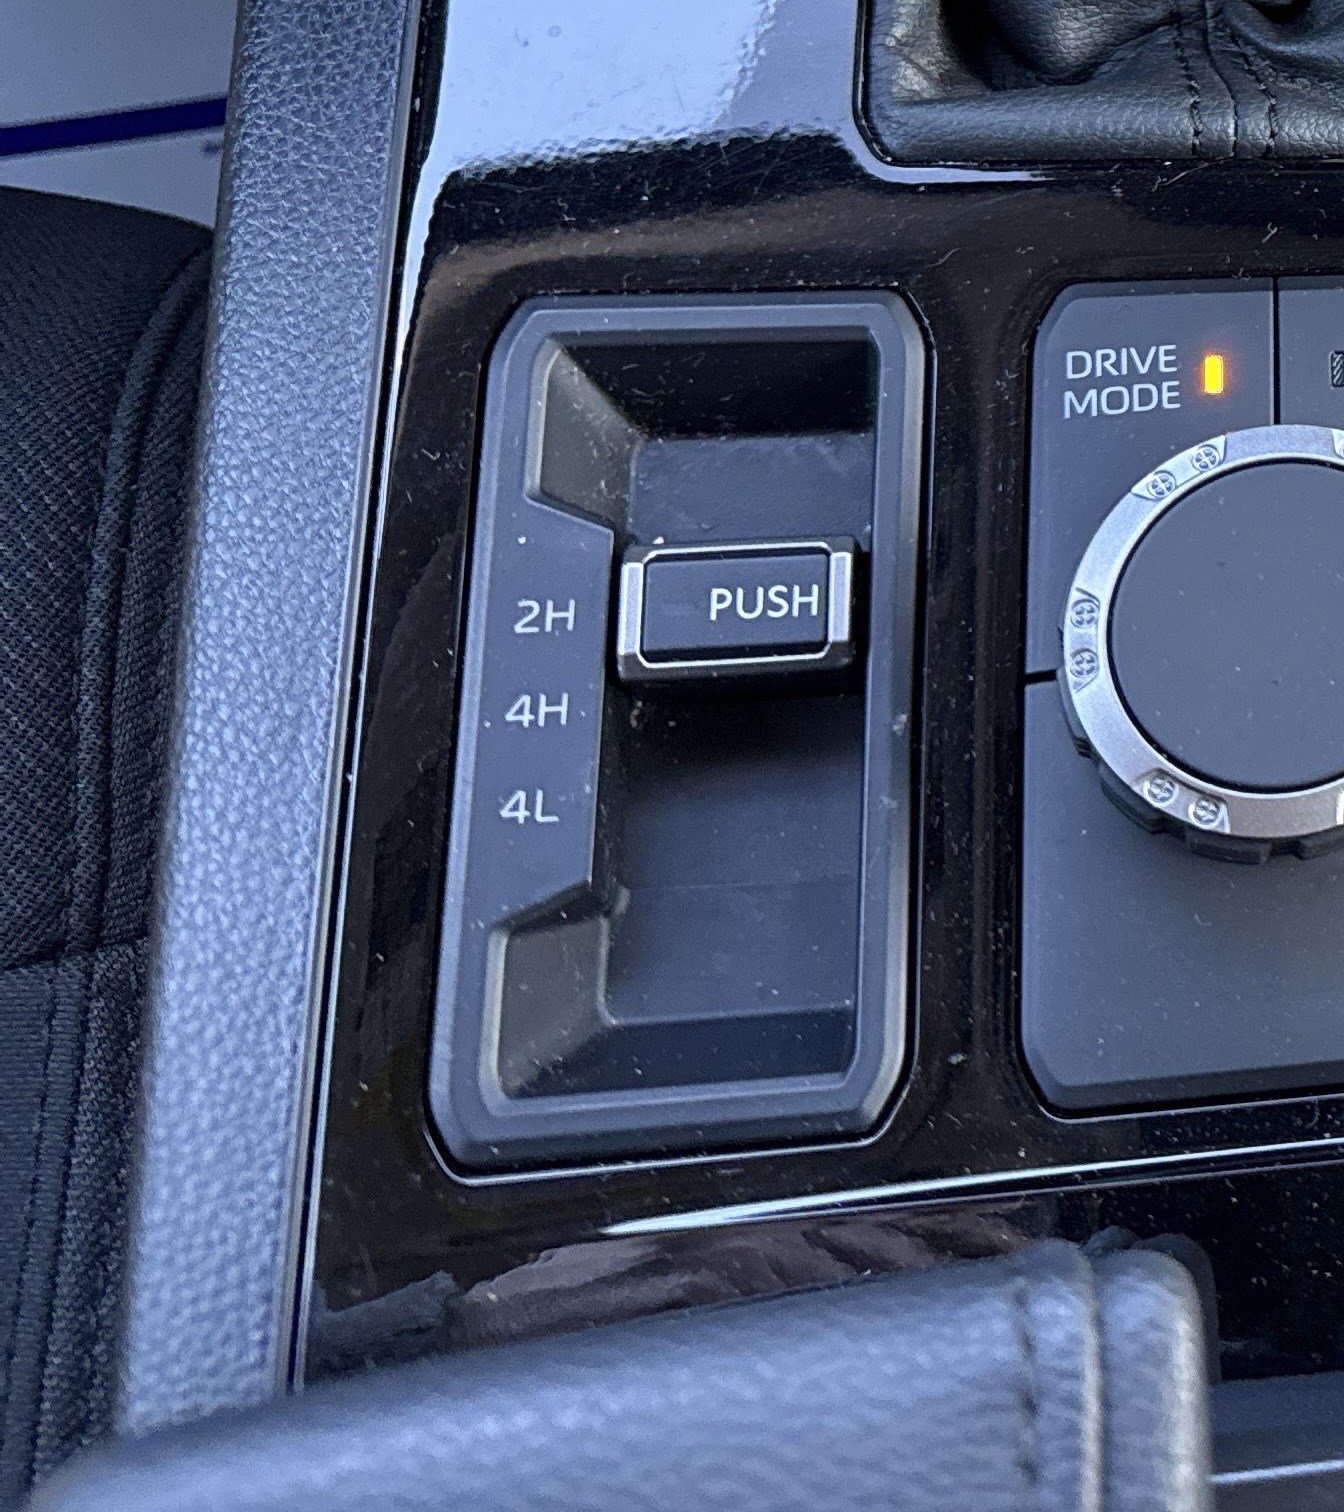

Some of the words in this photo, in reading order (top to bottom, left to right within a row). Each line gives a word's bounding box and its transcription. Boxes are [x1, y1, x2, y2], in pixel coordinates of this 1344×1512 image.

[1065, 344, 1178, 380] DRIVE
[1064, 380, 1181, 419] MODE
[514, 598, 576, 634] 2H
[709, 584, 819, 622] PUSH
[504, 693, 569, 728] 4H
[499, 789, 560, 824] 4L
